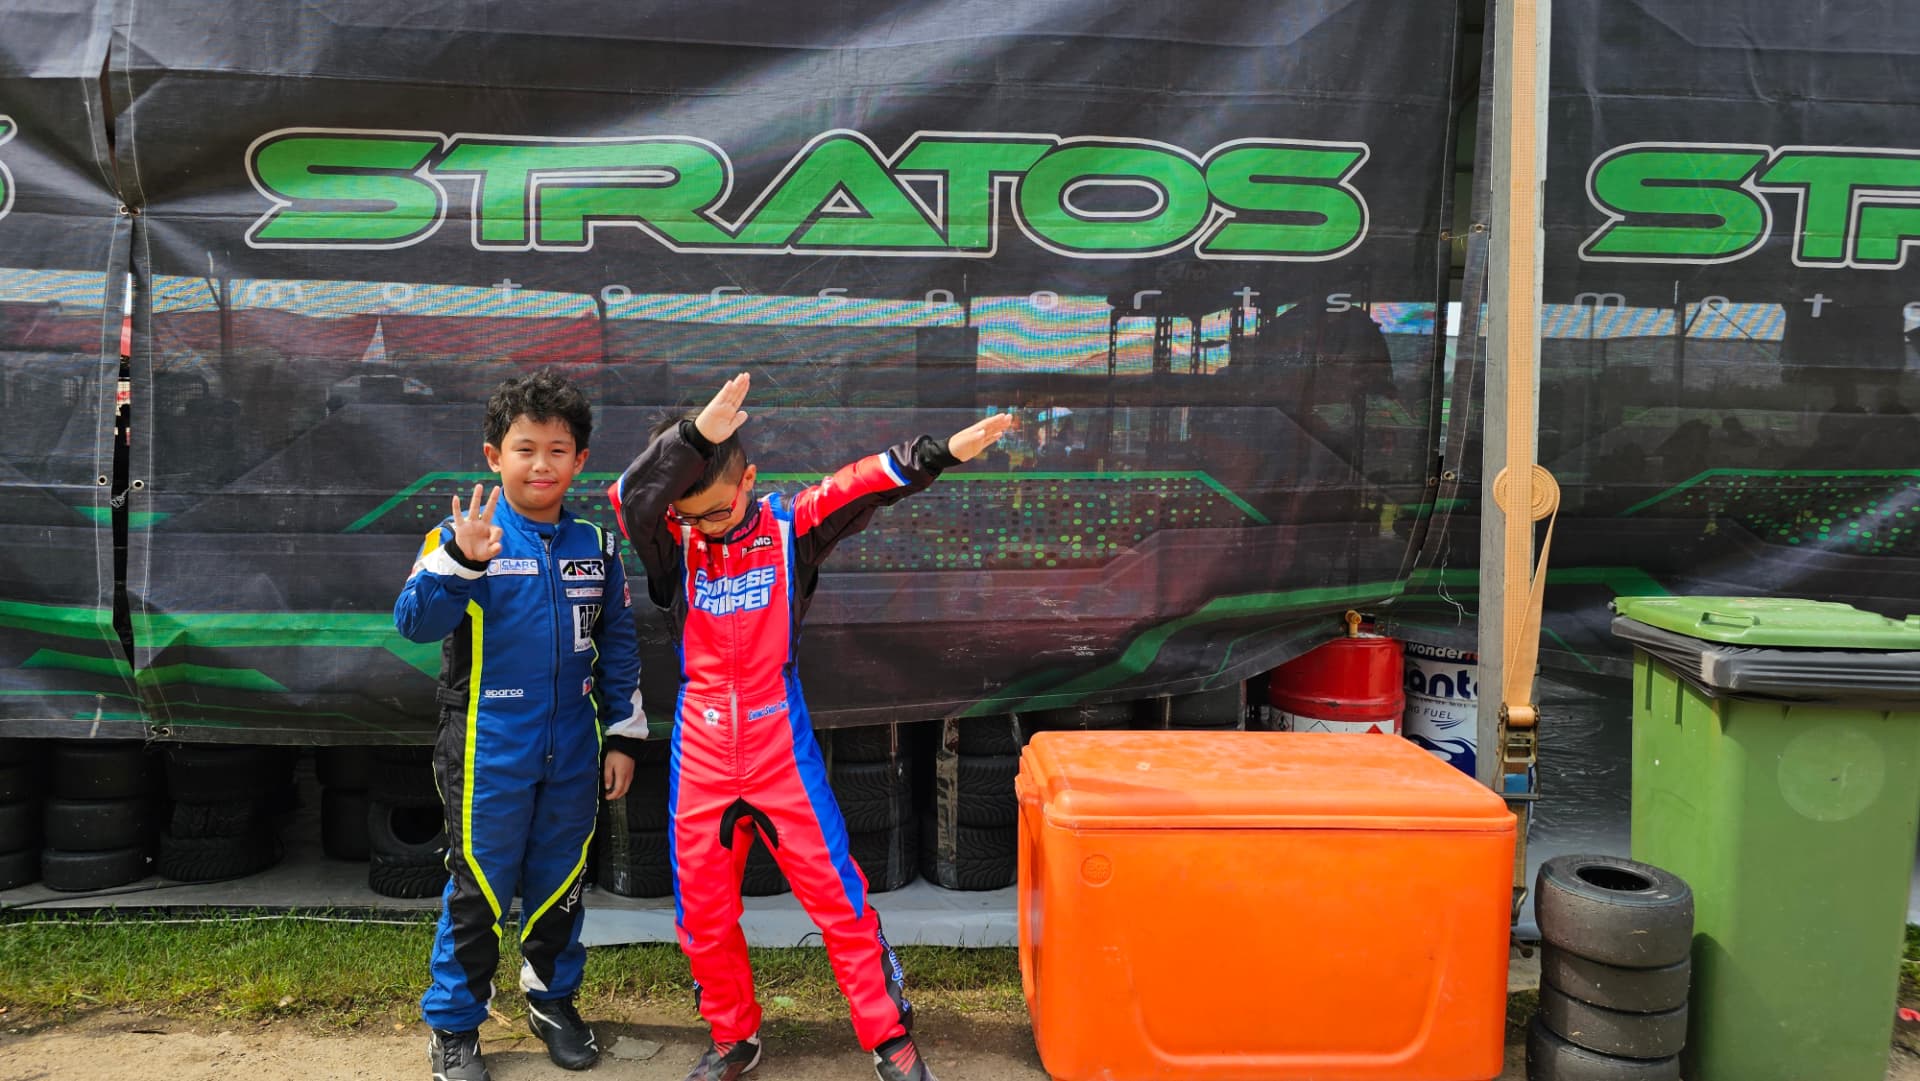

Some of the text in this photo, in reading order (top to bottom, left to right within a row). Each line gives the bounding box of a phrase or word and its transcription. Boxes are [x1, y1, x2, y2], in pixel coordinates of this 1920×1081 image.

[245, 127, 1370, 262] STRATOS
[693, 586, 771, 616] TAIPEI
[484, 688, 524, 698] sparco
[1408, 669, 1478, 700] ant
[1423, 706, 1454, 720] FUEL
